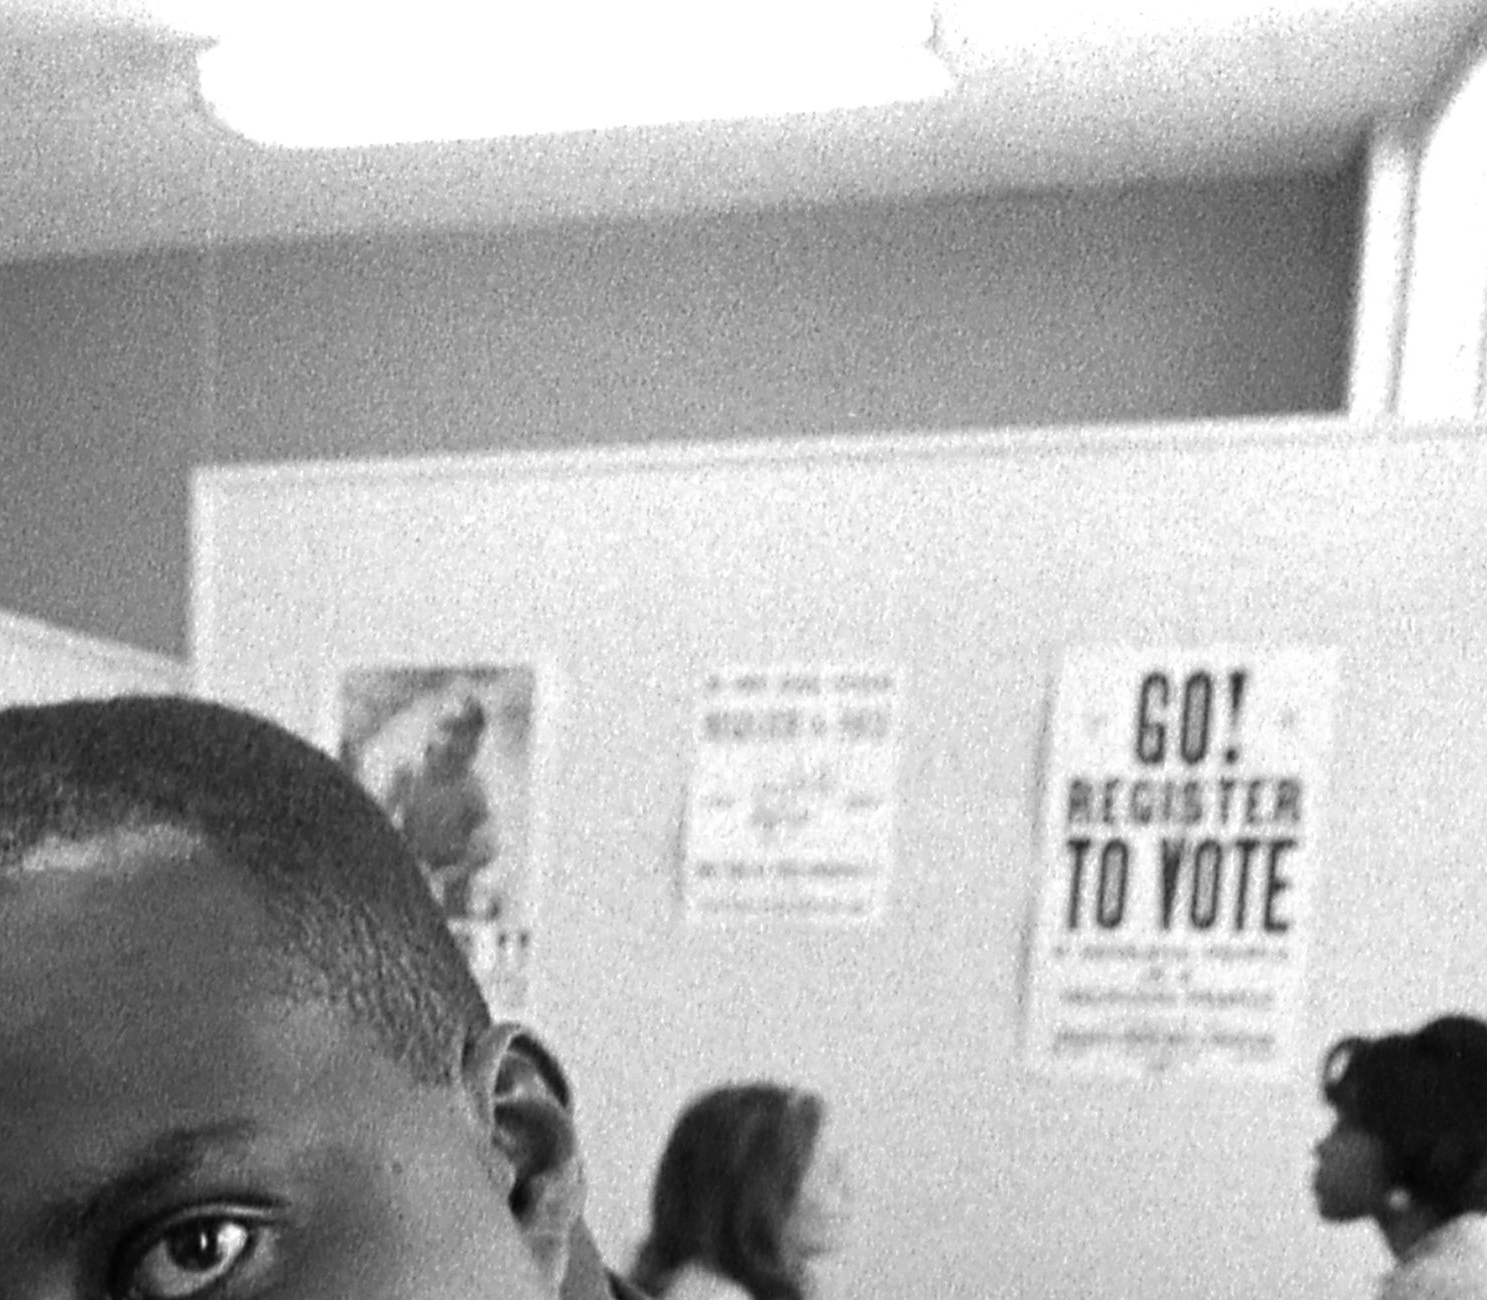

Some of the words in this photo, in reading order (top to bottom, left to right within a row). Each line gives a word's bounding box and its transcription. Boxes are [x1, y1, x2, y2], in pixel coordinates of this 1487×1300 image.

[1133, 668, 1249, 766] GO!
[1065, 778, 1305, 826] REGISTER
[1064, 837, 1131, 932] TO
[1160, 837, 1300, 934] VOTE
